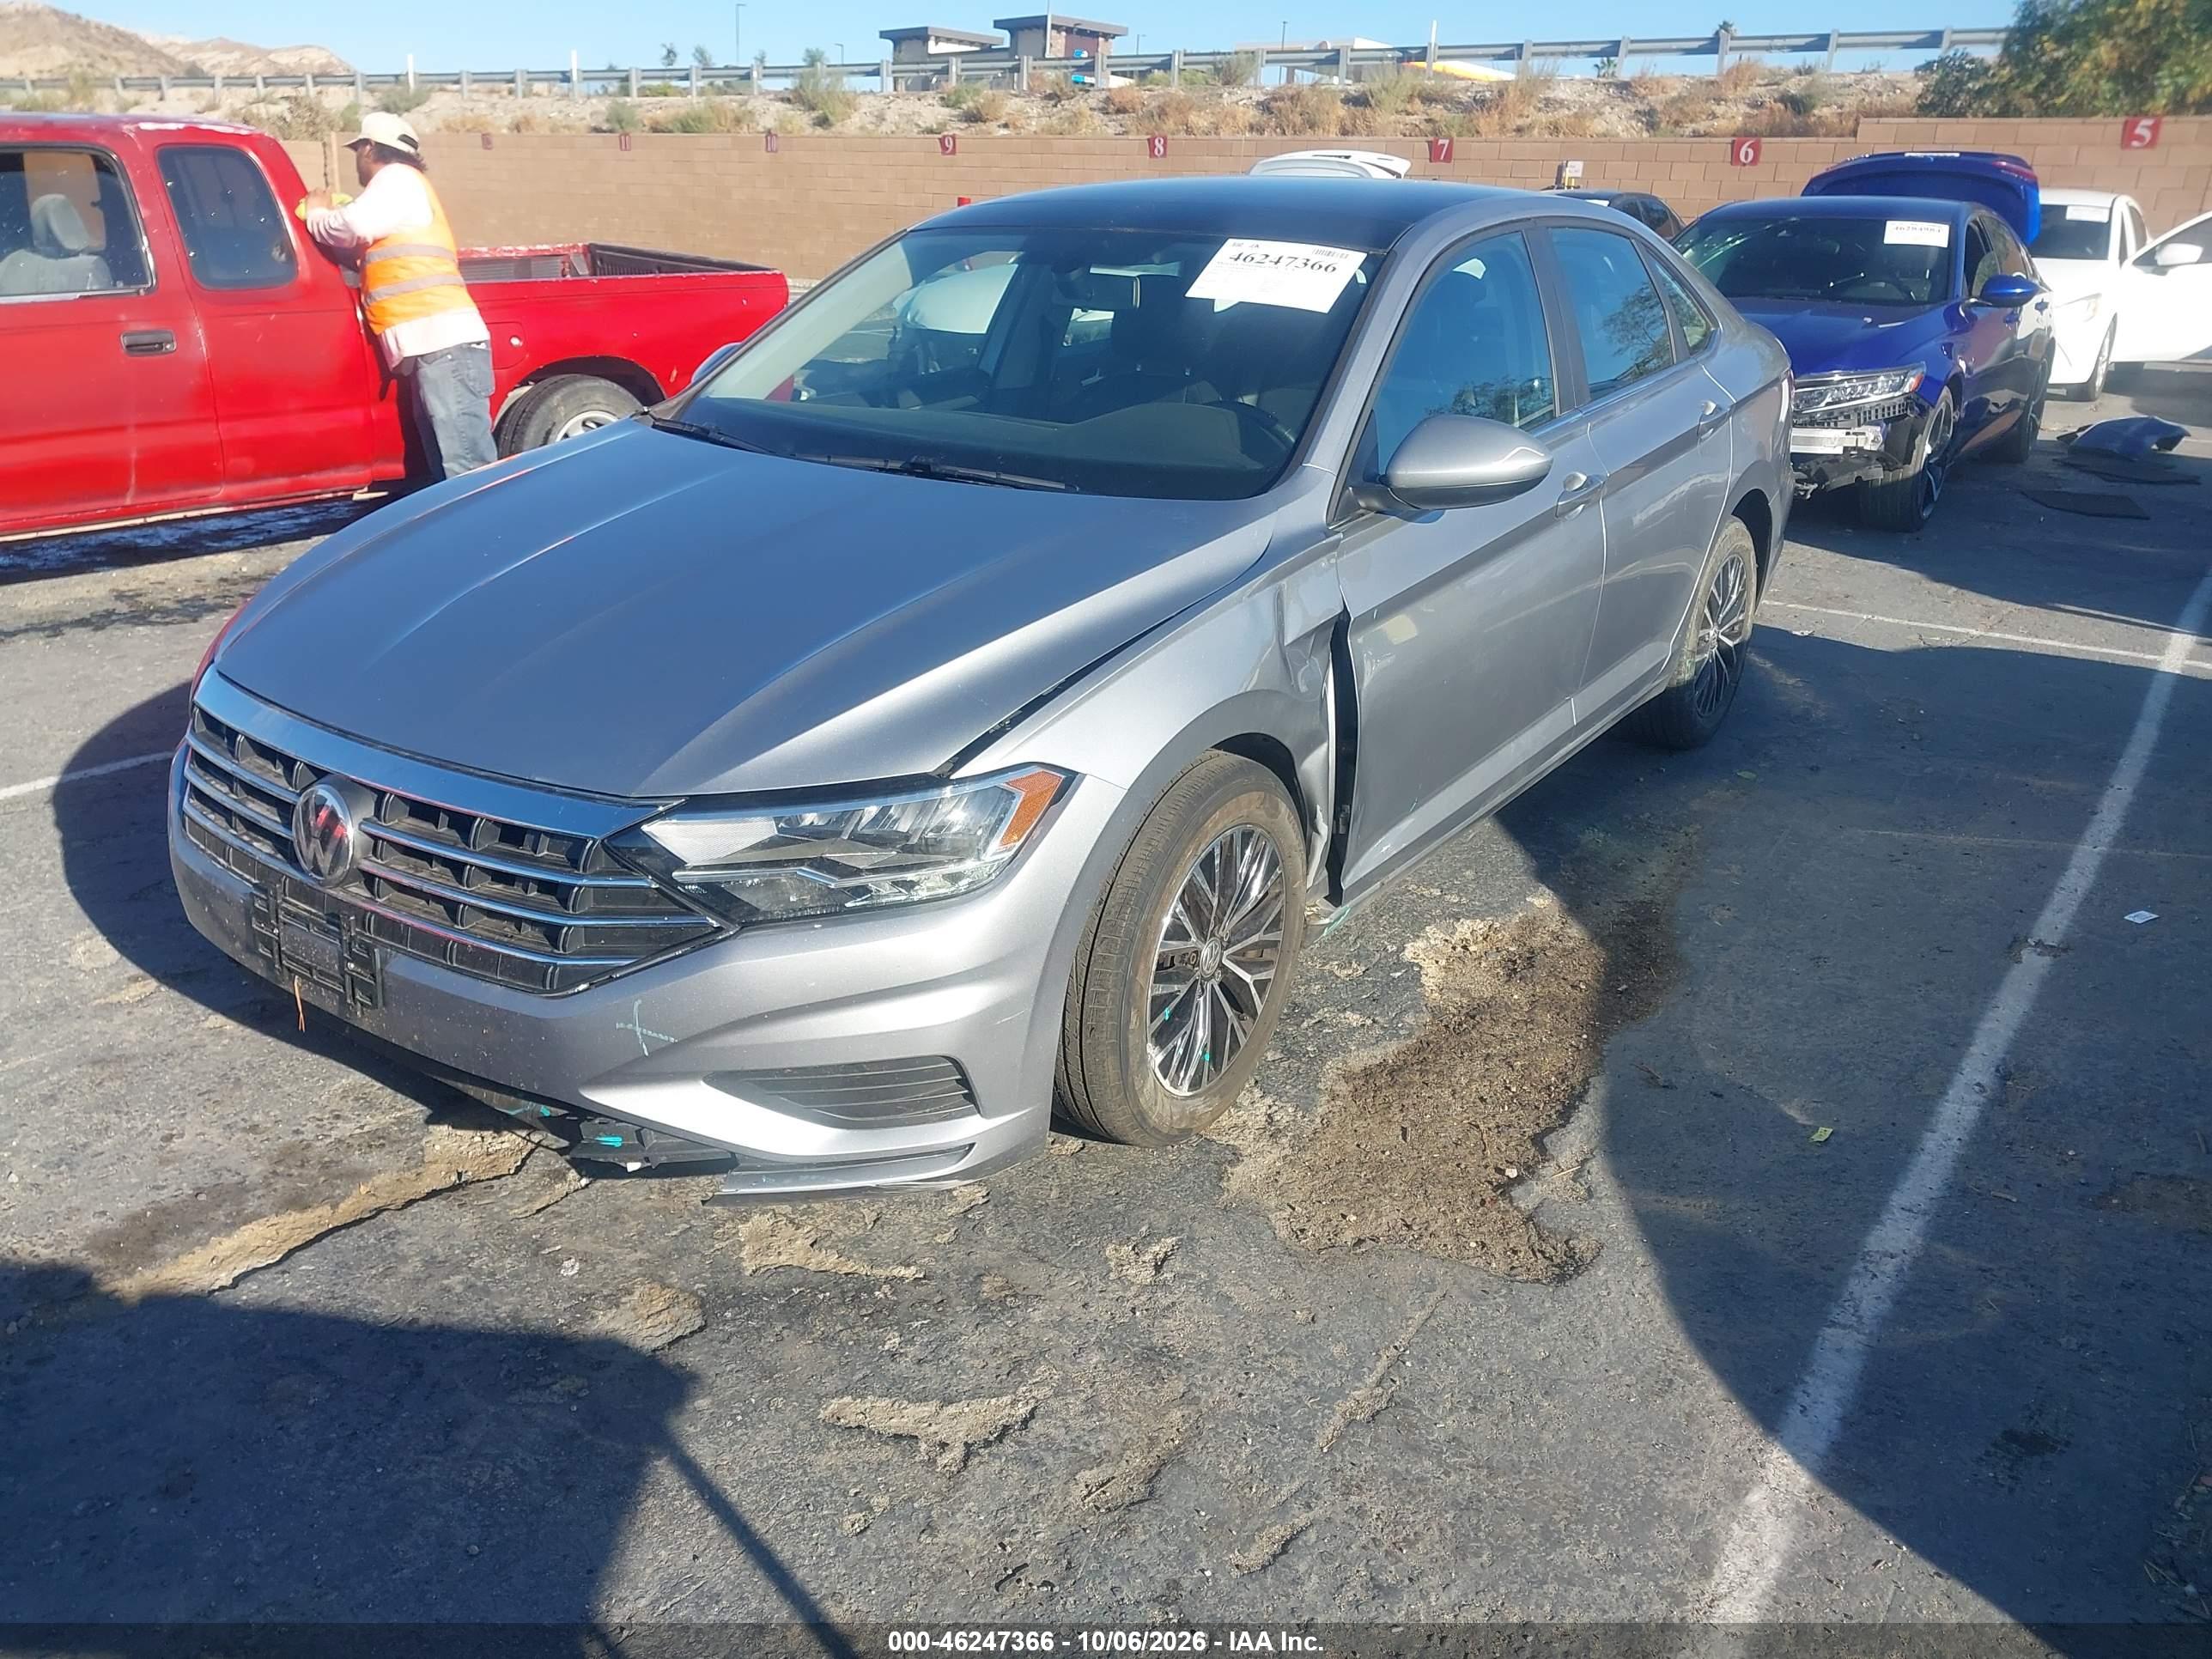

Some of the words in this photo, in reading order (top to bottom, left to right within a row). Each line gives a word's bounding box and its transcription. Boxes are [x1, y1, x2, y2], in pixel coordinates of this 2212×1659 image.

[2130, 118, 2154, 147] 5
[945, 136, 953, 153] 9
[1154, 137, 1164, 155] 8
[1437, 138, 1449, 161] 7
[1739, 139, 1754, 163] 6
[1229, 252, 1338, 273] 46247366
